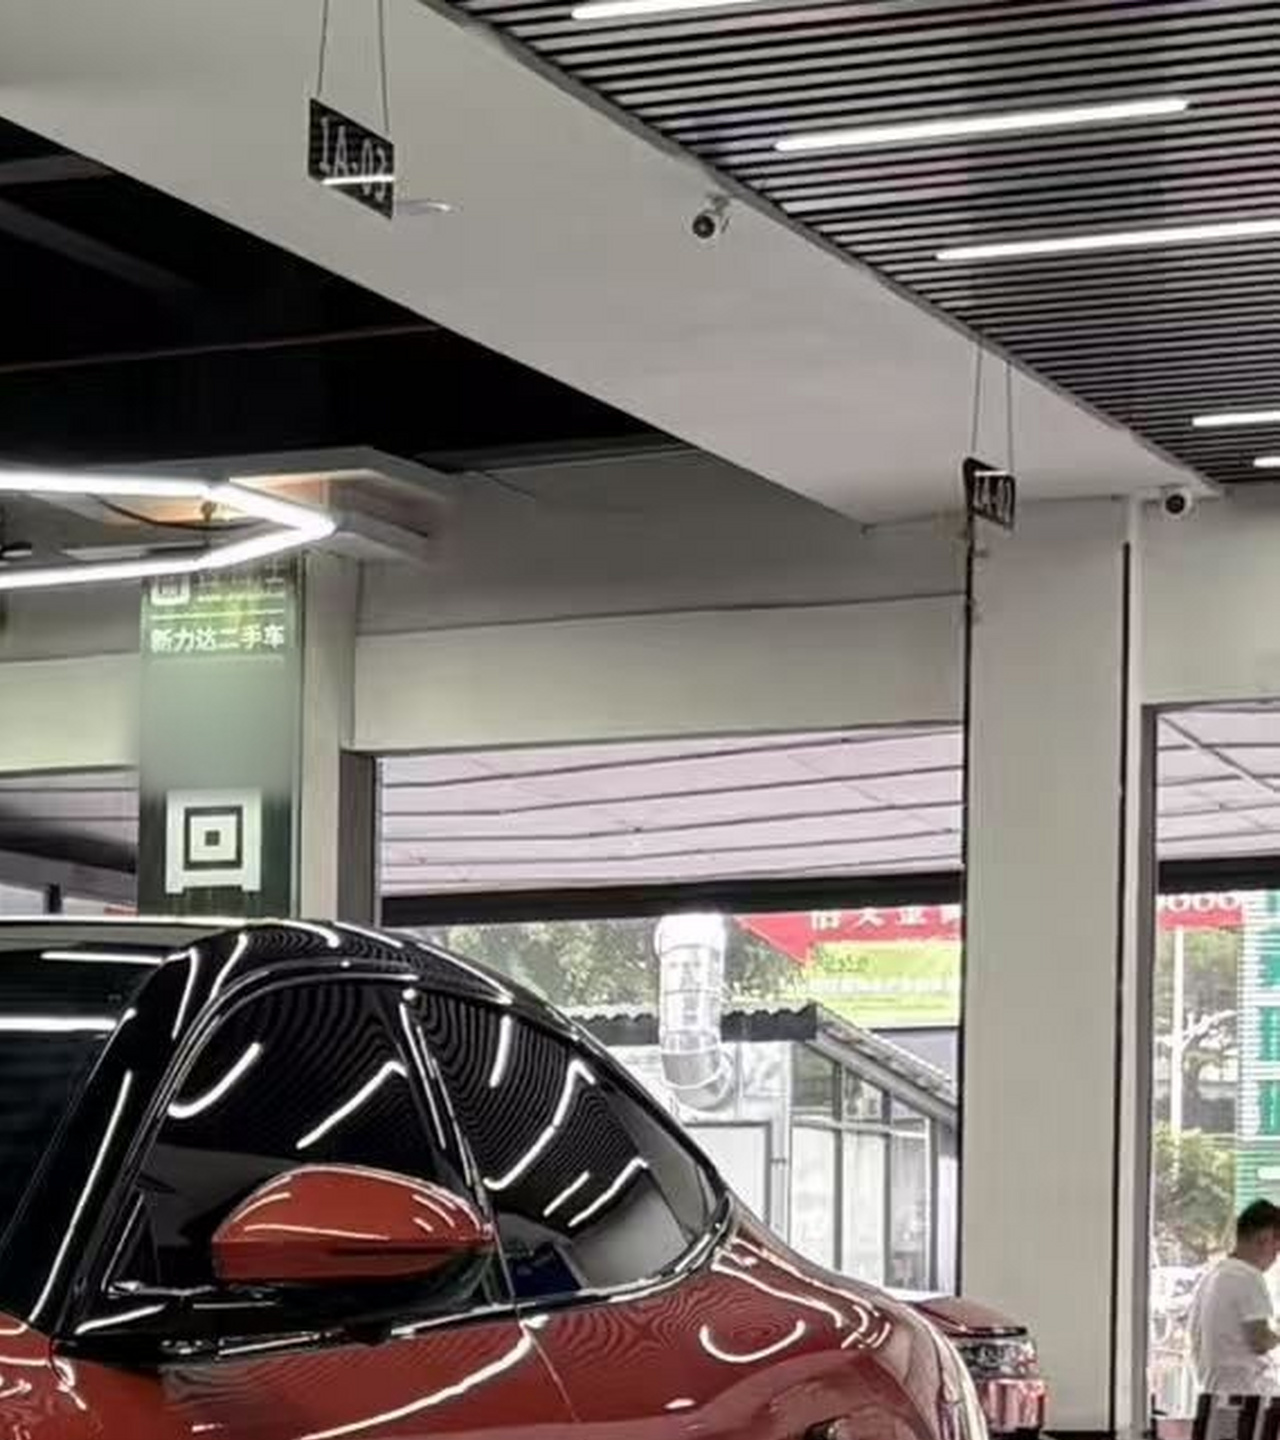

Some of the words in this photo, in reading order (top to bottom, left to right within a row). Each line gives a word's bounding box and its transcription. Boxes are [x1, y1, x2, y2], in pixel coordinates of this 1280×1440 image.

[151, 623, 285, 652] 新力达二手车
